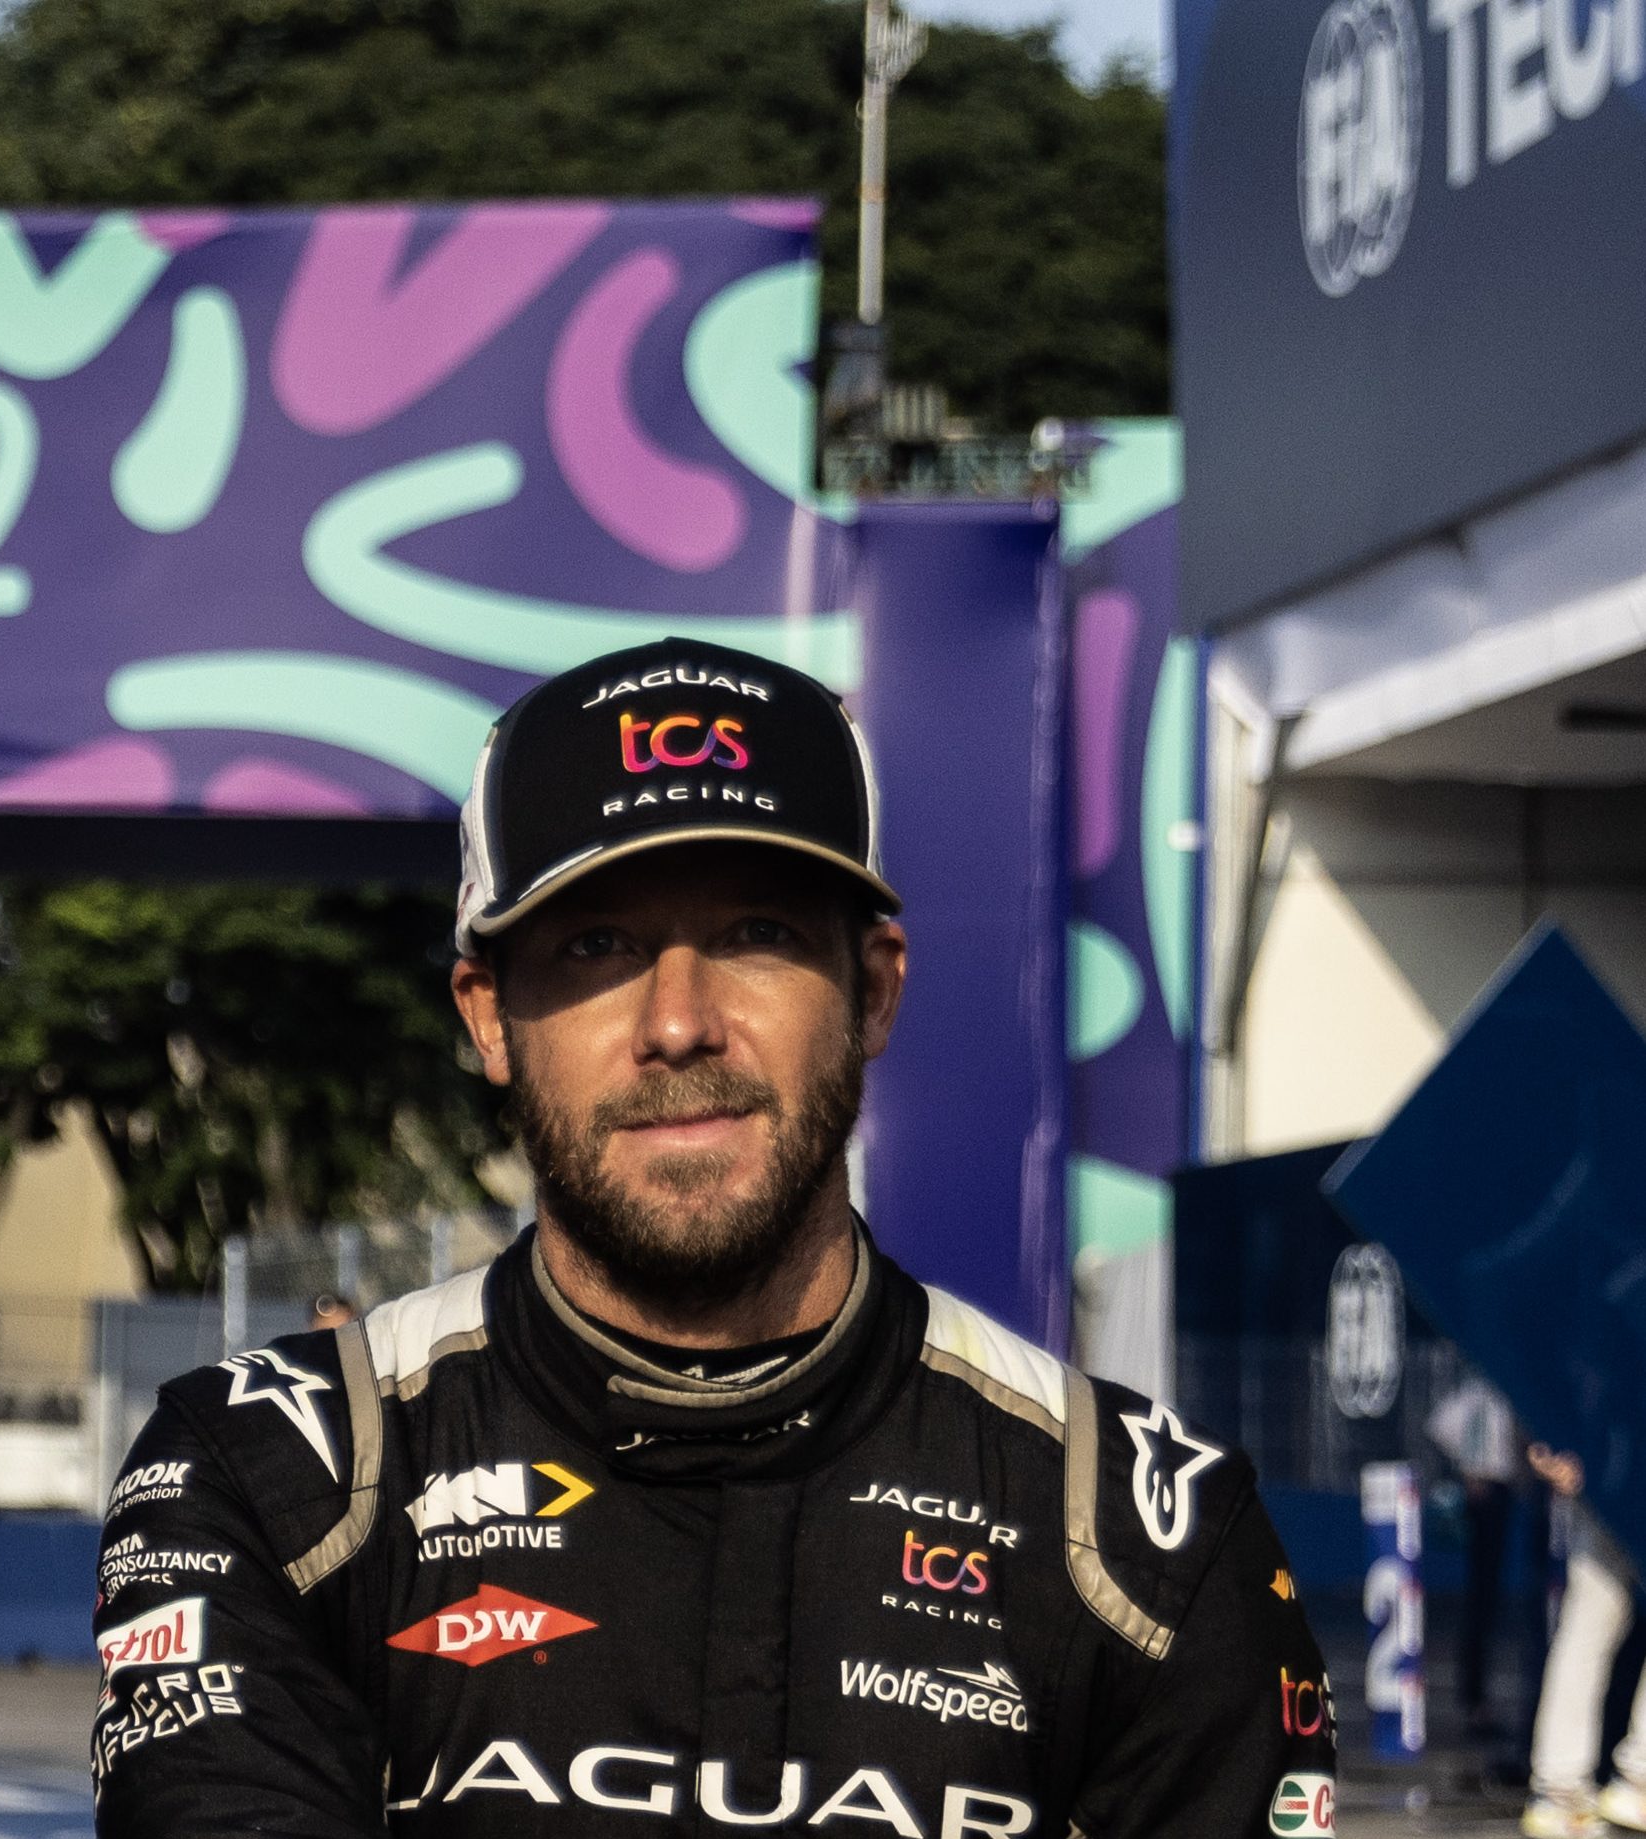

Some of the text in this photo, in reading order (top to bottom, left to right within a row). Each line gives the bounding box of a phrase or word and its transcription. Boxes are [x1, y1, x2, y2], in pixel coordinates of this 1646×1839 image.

[582, 668, 769, 708] JAGUAR
[619, 713, 750, 773] tcs
[603, 786, 775, 816] RACING
[123, 1485, 183, 1508] emotion
[849, 1484, 1019, 1549] JAGUR
[99, 1551, 232, 1582] CONSULTANCY
[102, 1532, 145, 1562] TATA
[902, 1530, 990, 1594] tcs
[881, 1594, 1003, 1631] RACING
[103, 1663, 233, 1743] MICRO
[105, 1693, 242, 1773] FOCUS
